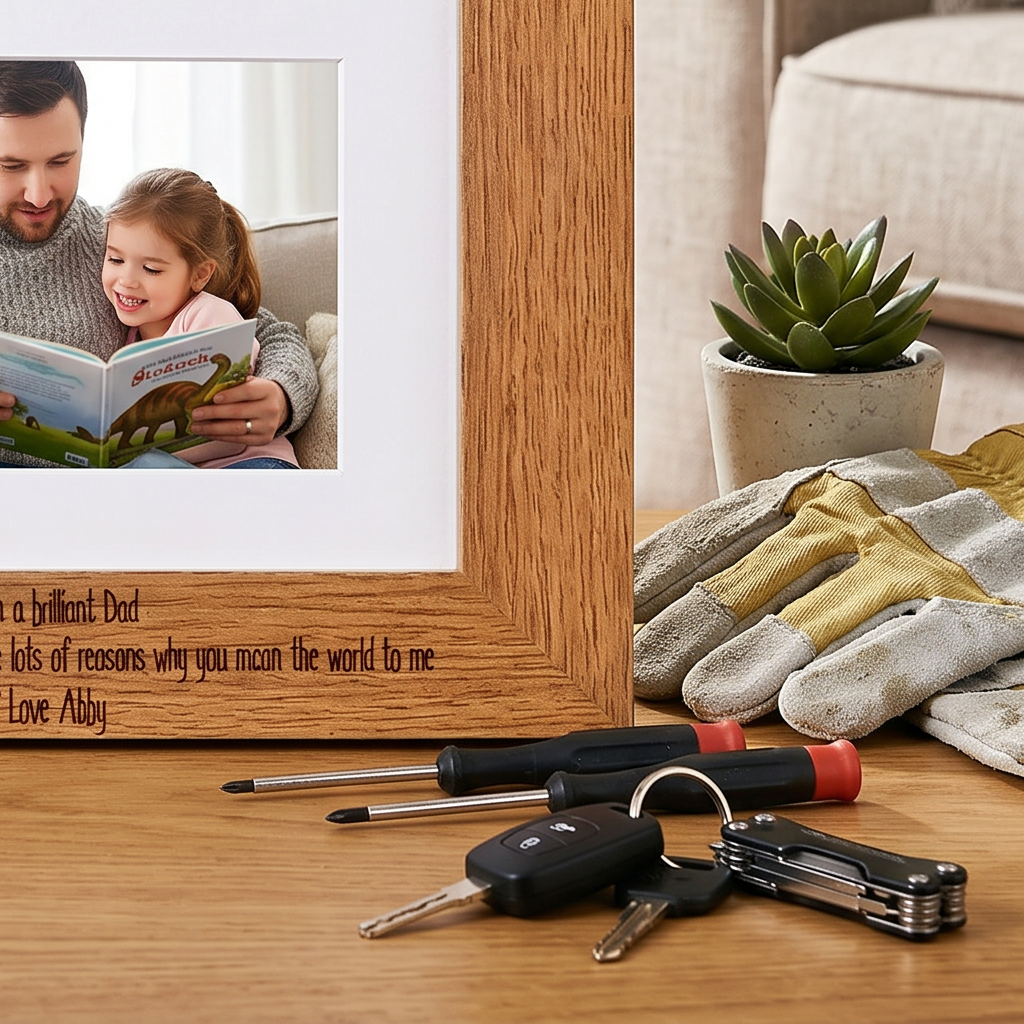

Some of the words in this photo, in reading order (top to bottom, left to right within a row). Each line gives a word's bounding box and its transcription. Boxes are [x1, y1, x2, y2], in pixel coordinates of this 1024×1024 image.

[12, 600, 26, 623] a
[32, 587, 97, 627] brilliant
[103, 588, 140, 623] Dad
[11, 636, 43, 672] lots
[50, 636, 72, 672] of
[78, 647, 146, 672] reasons
[152, 636, 188, 683] why
[195, 647, 229, 683] you
[289, 635, 319, 671] the
[326, 635, 375, 672] world
[381, 636, 402, 672] to
[409, 648, 435, 671] me
[9, 687, 50, 725] Love
[58, 687, 107, 736] Abby
